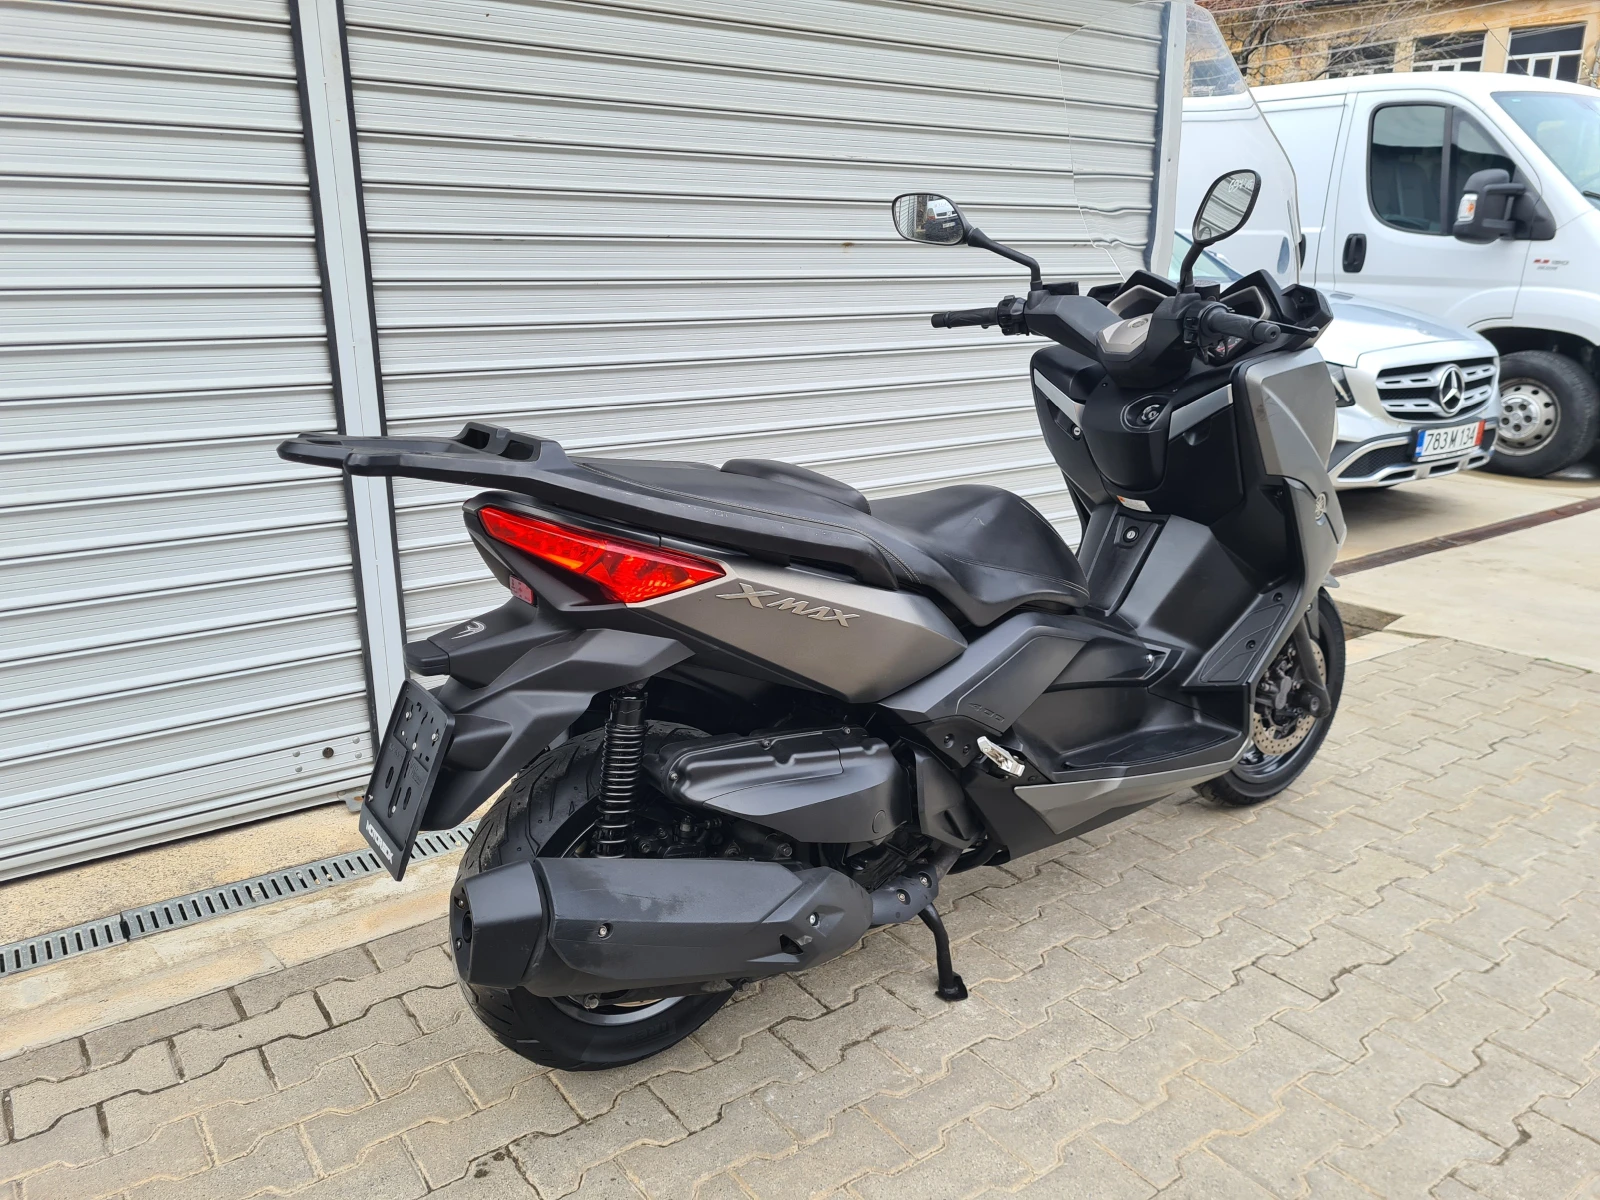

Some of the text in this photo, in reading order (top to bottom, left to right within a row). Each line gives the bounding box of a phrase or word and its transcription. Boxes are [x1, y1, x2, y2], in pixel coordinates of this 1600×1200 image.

[1425, 432, 1448, 451] 783
[1459, 425, 1476, 446] 134
[968, 702, 1005, 722] 400
